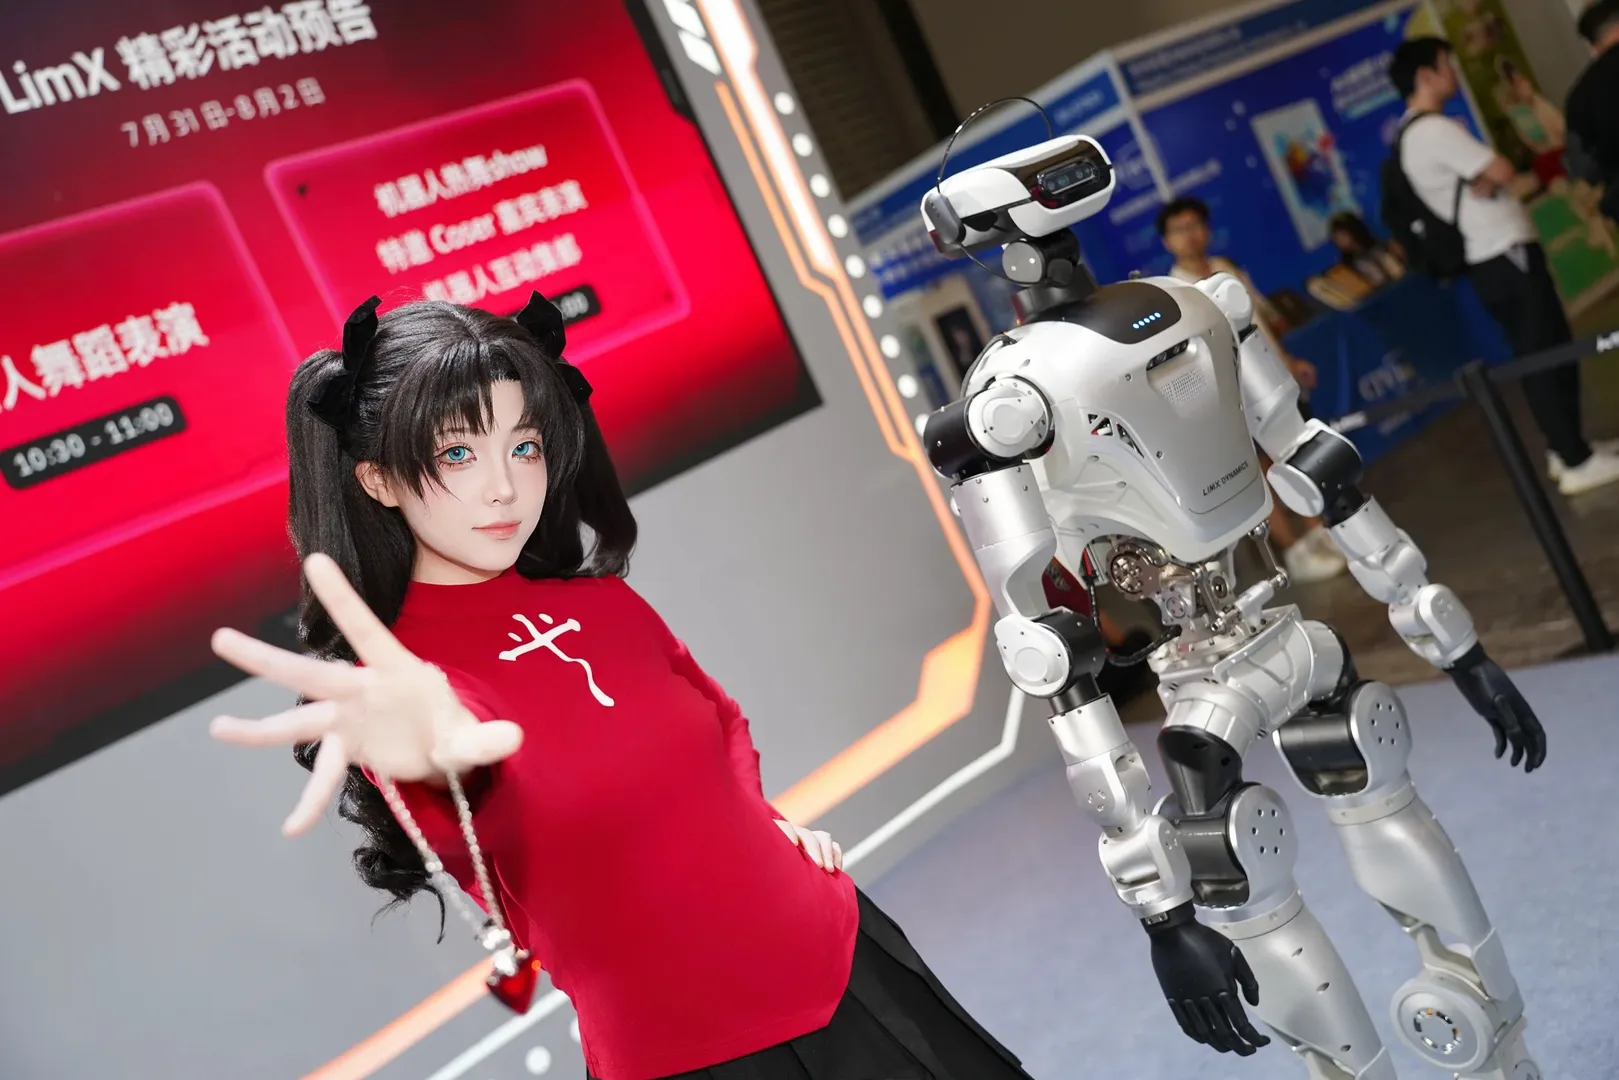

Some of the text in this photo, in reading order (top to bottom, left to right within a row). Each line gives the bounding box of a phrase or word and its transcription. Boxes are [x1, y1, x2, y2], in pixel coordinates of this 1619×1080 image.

[0, 0, 378, 114] LimX 精彩活动预告
[428, 212, 497, 254] Coser
[0, 301, 210, 413] 人舞蹈表演
[13, 433, 86, 478] 10:30
[104, 402, 174, 445] 11:00
[1202, 461, 1249, 497] LIMX DYNAMICS
